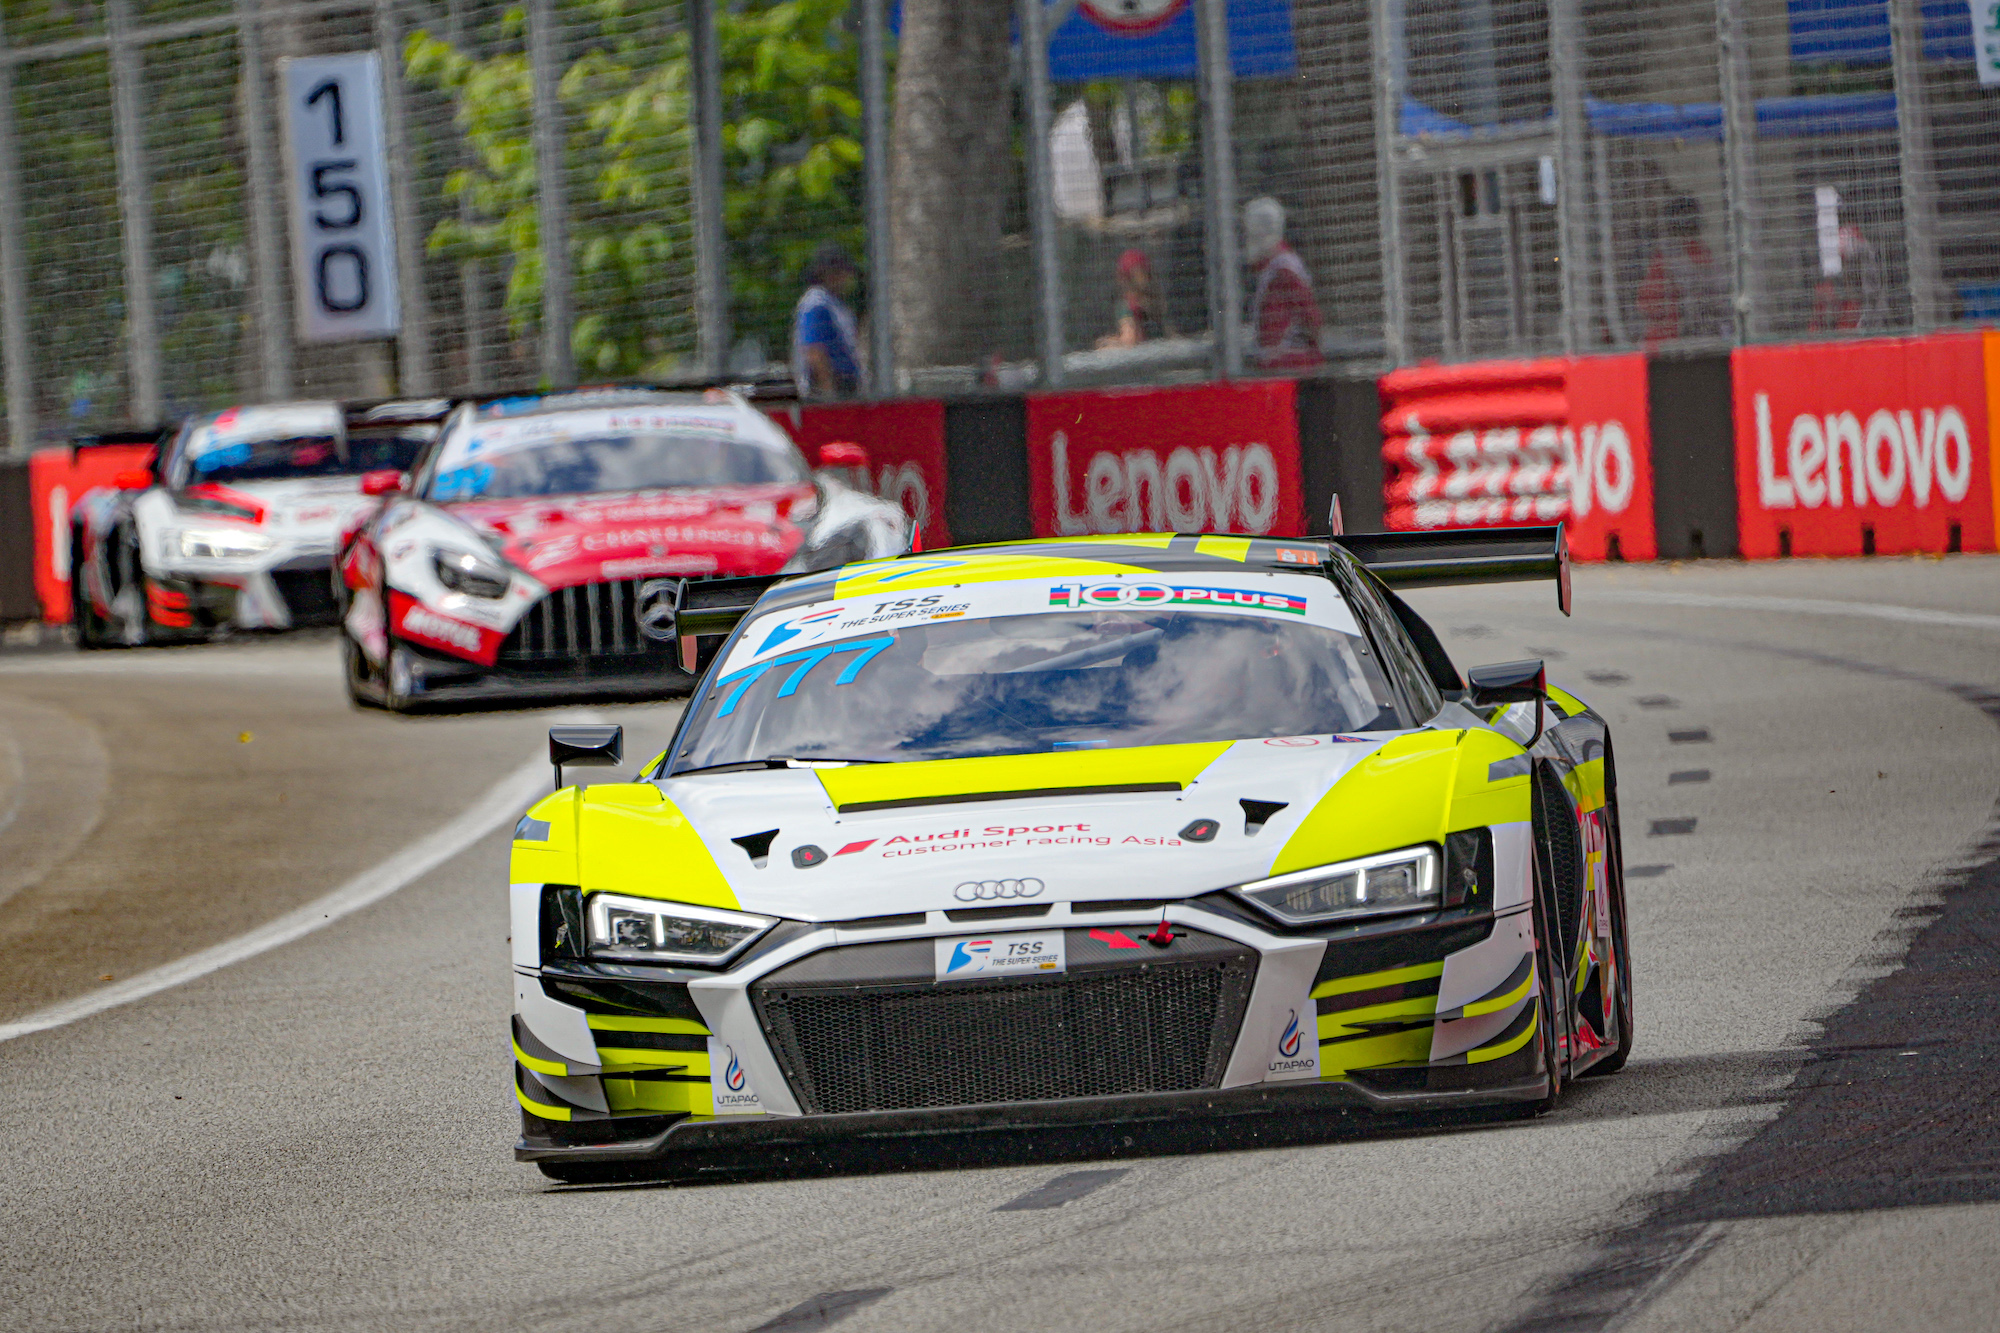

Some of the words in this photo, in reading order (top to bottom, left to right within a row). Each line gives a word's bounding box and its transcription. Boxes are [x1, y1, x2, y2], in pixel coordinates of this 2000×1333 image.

[306, 80, 371, 314] 150
[1755, 391, 1972, 508] Lenovo
[1053, 430, 1280, 536] Lenovo
[841, 617, 869, 629] THE
[869, 609, 917, 624] SUPER
[918, 603, 971, 616] SERIES
[873, 595, 944, 614] TSS
[716, 636, 895, 719] 777
[882, 838, 1013, 858] customer
[1026, 834, 1111, 847] racing
[1121, 835, 1182, 847] Asia
[883, 828, 970, 847] Audi
[983, 822, 1092, 837] Sport
[992, 958, 1006, 967] THE
[1006, 956, 1030, 965] SUPER
[1031, 954, 1059, 963] SERIES
[1007, 941, 1044, 956] TSS
[1268, 1059, 1315, 1071] UTAPAO
[716, 1094, 760, 1105] UTAPAO
